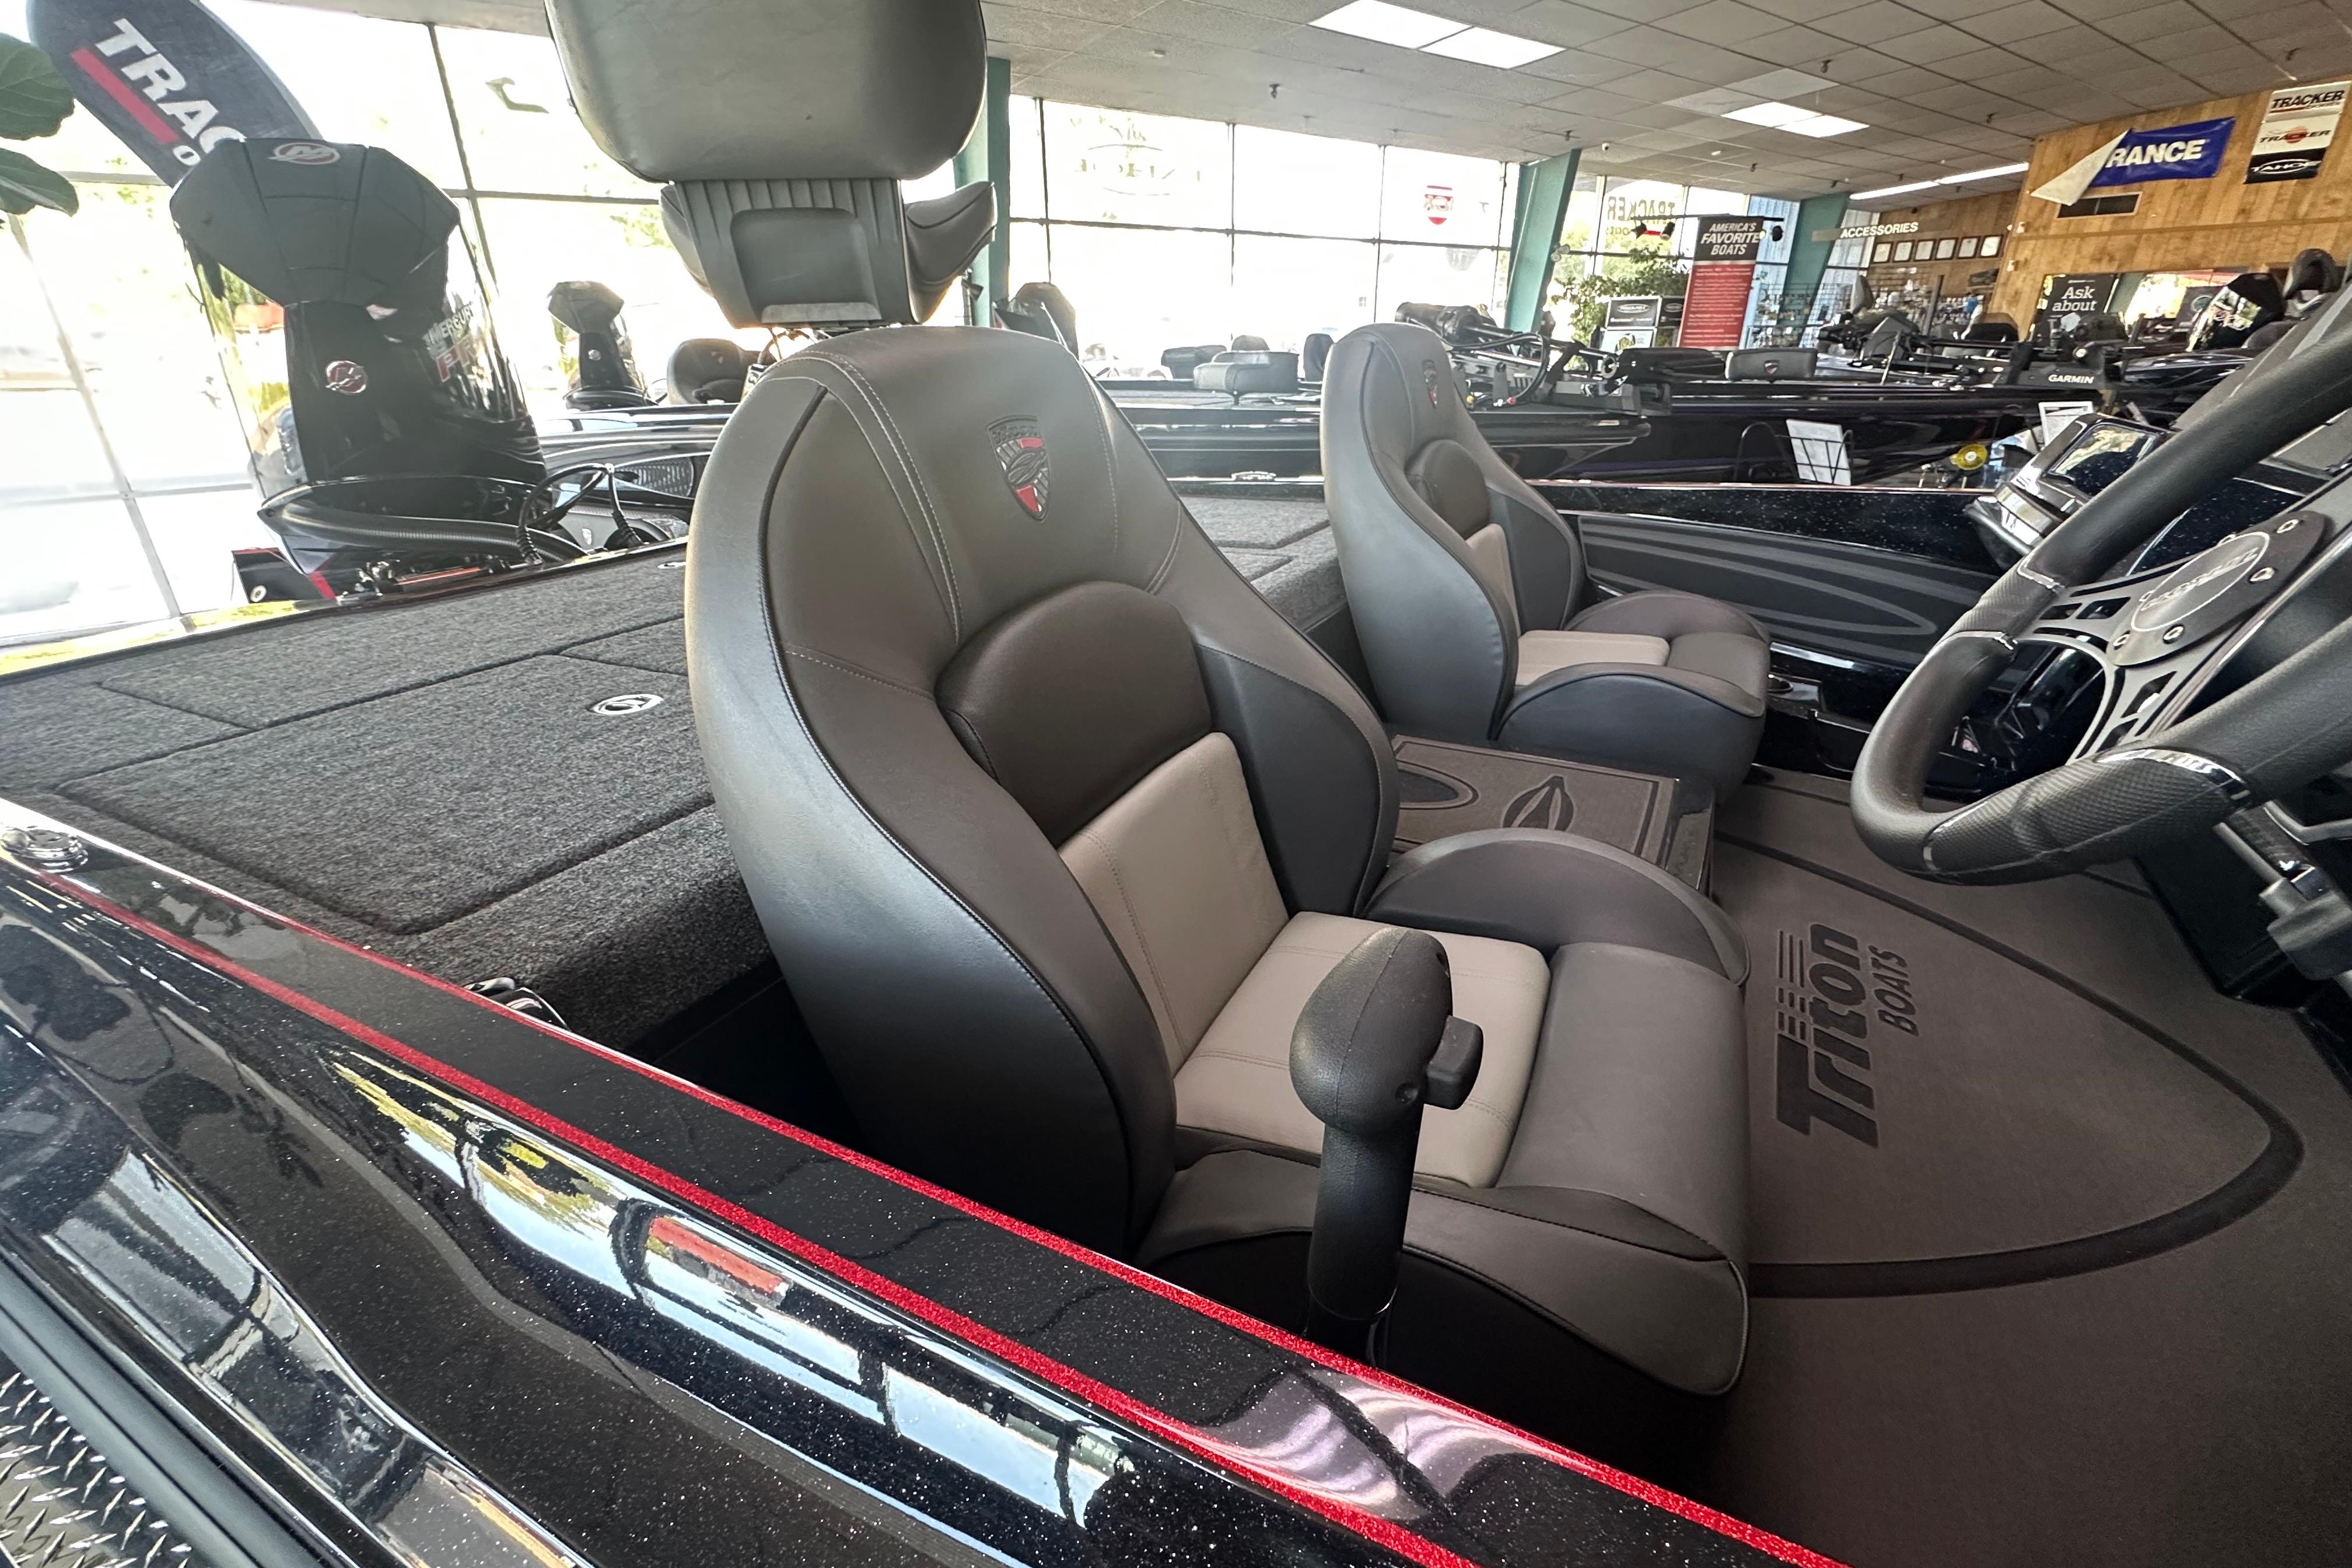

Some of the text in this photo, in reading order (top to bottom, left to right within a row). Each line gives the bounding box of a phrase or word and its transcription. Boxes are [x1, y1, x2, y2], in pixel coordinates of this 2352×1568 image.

[2272, 90, 2344, 108] TRACKER
[2105, 139, 2206, 167] RANCE
[1709, 223, 1756, 232] AMERICA'S
[1840, 222, 1918, 238] ACCESSORIES
[1700, 232, 1760, 244] FAVORITE
[1711, 244, 1746, 255] BOATS
[2062, 286, 2095, 299] Ask
[2052, 300, 2097, 312] about
[428, 301, 474, 344] MERCUR
[2048, 374, 2094, 384] GARMIN
[1868, 944, 1919, 1036] BOATS
